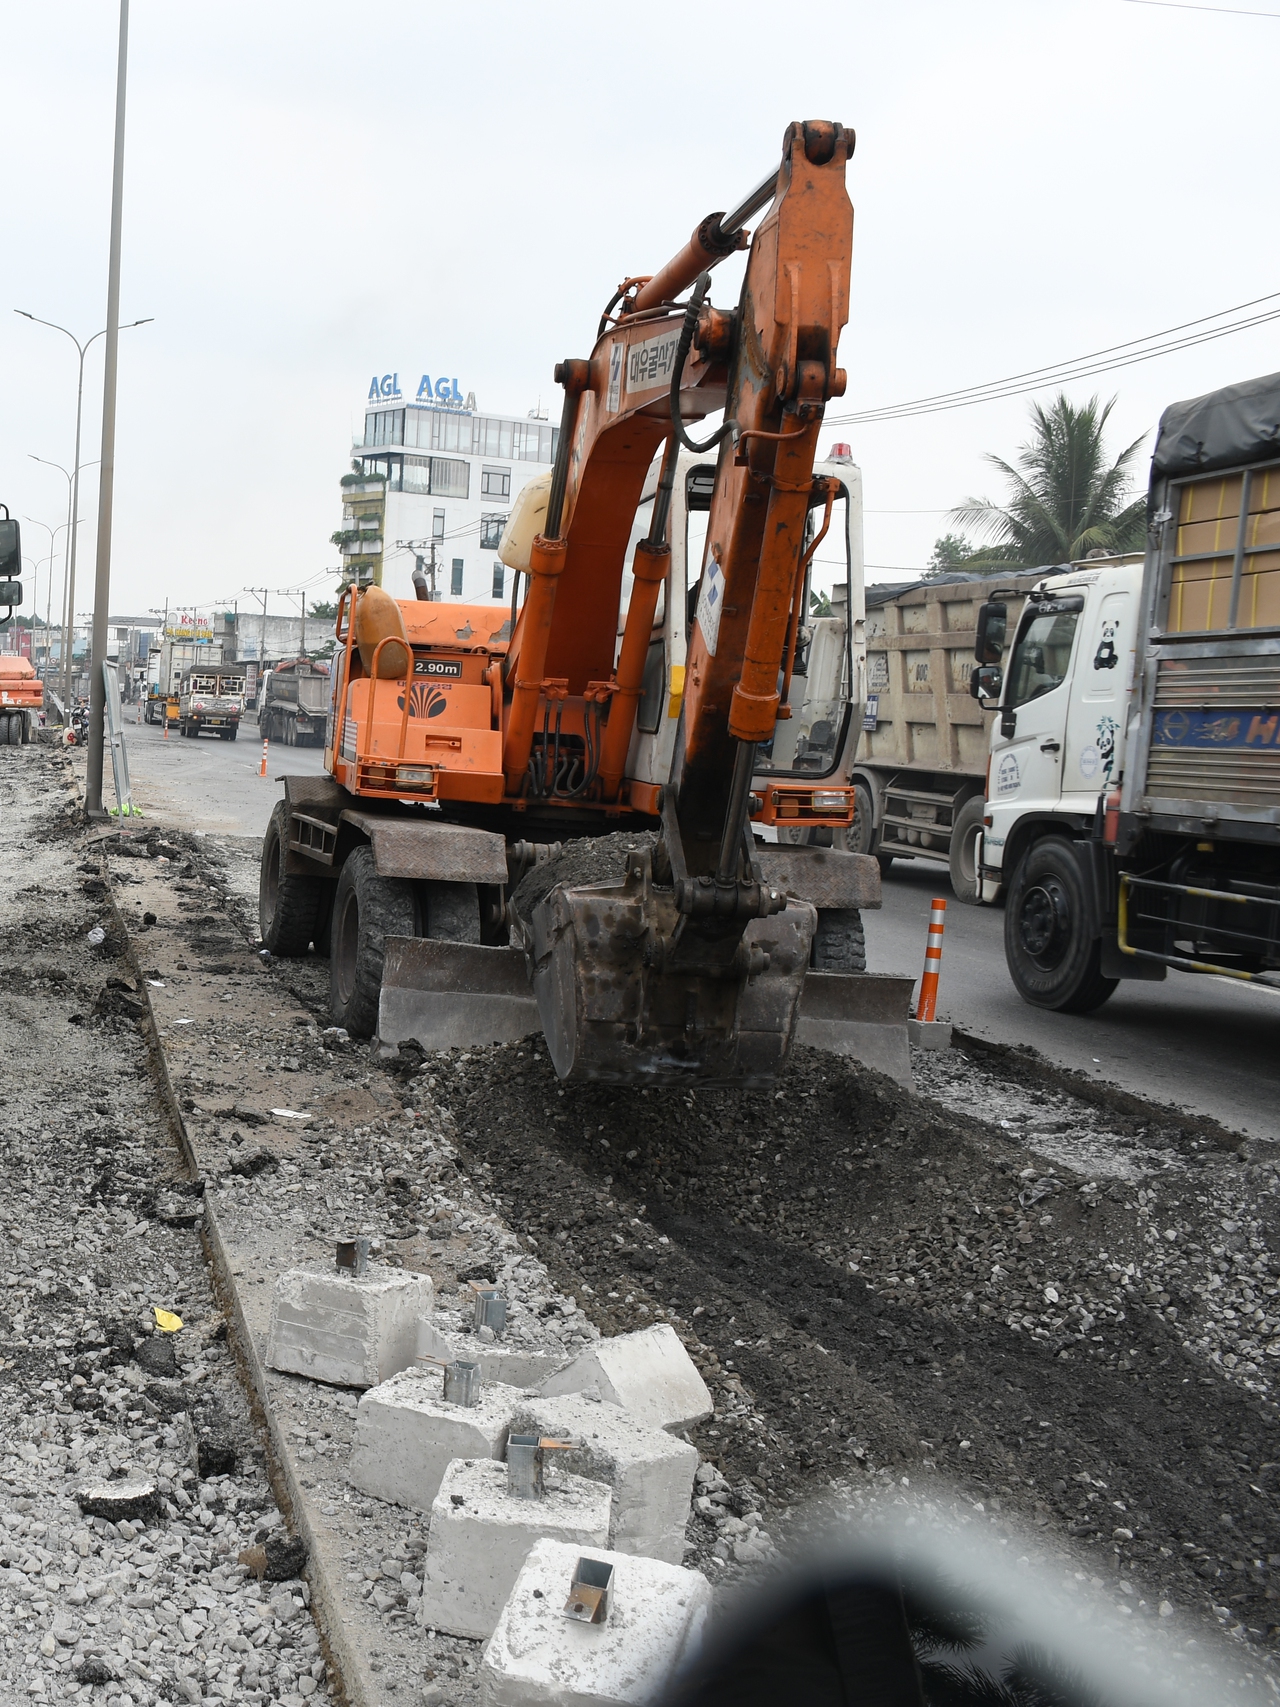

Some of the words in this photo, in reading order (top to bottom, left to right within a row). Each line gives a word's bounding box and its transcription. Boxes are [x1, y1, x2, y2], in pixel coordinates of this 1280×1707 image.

[368, 373, 401, 399] AGL
[416, 374, 464, 402] AGL
[415, 662, 457, 674] 2.90m
